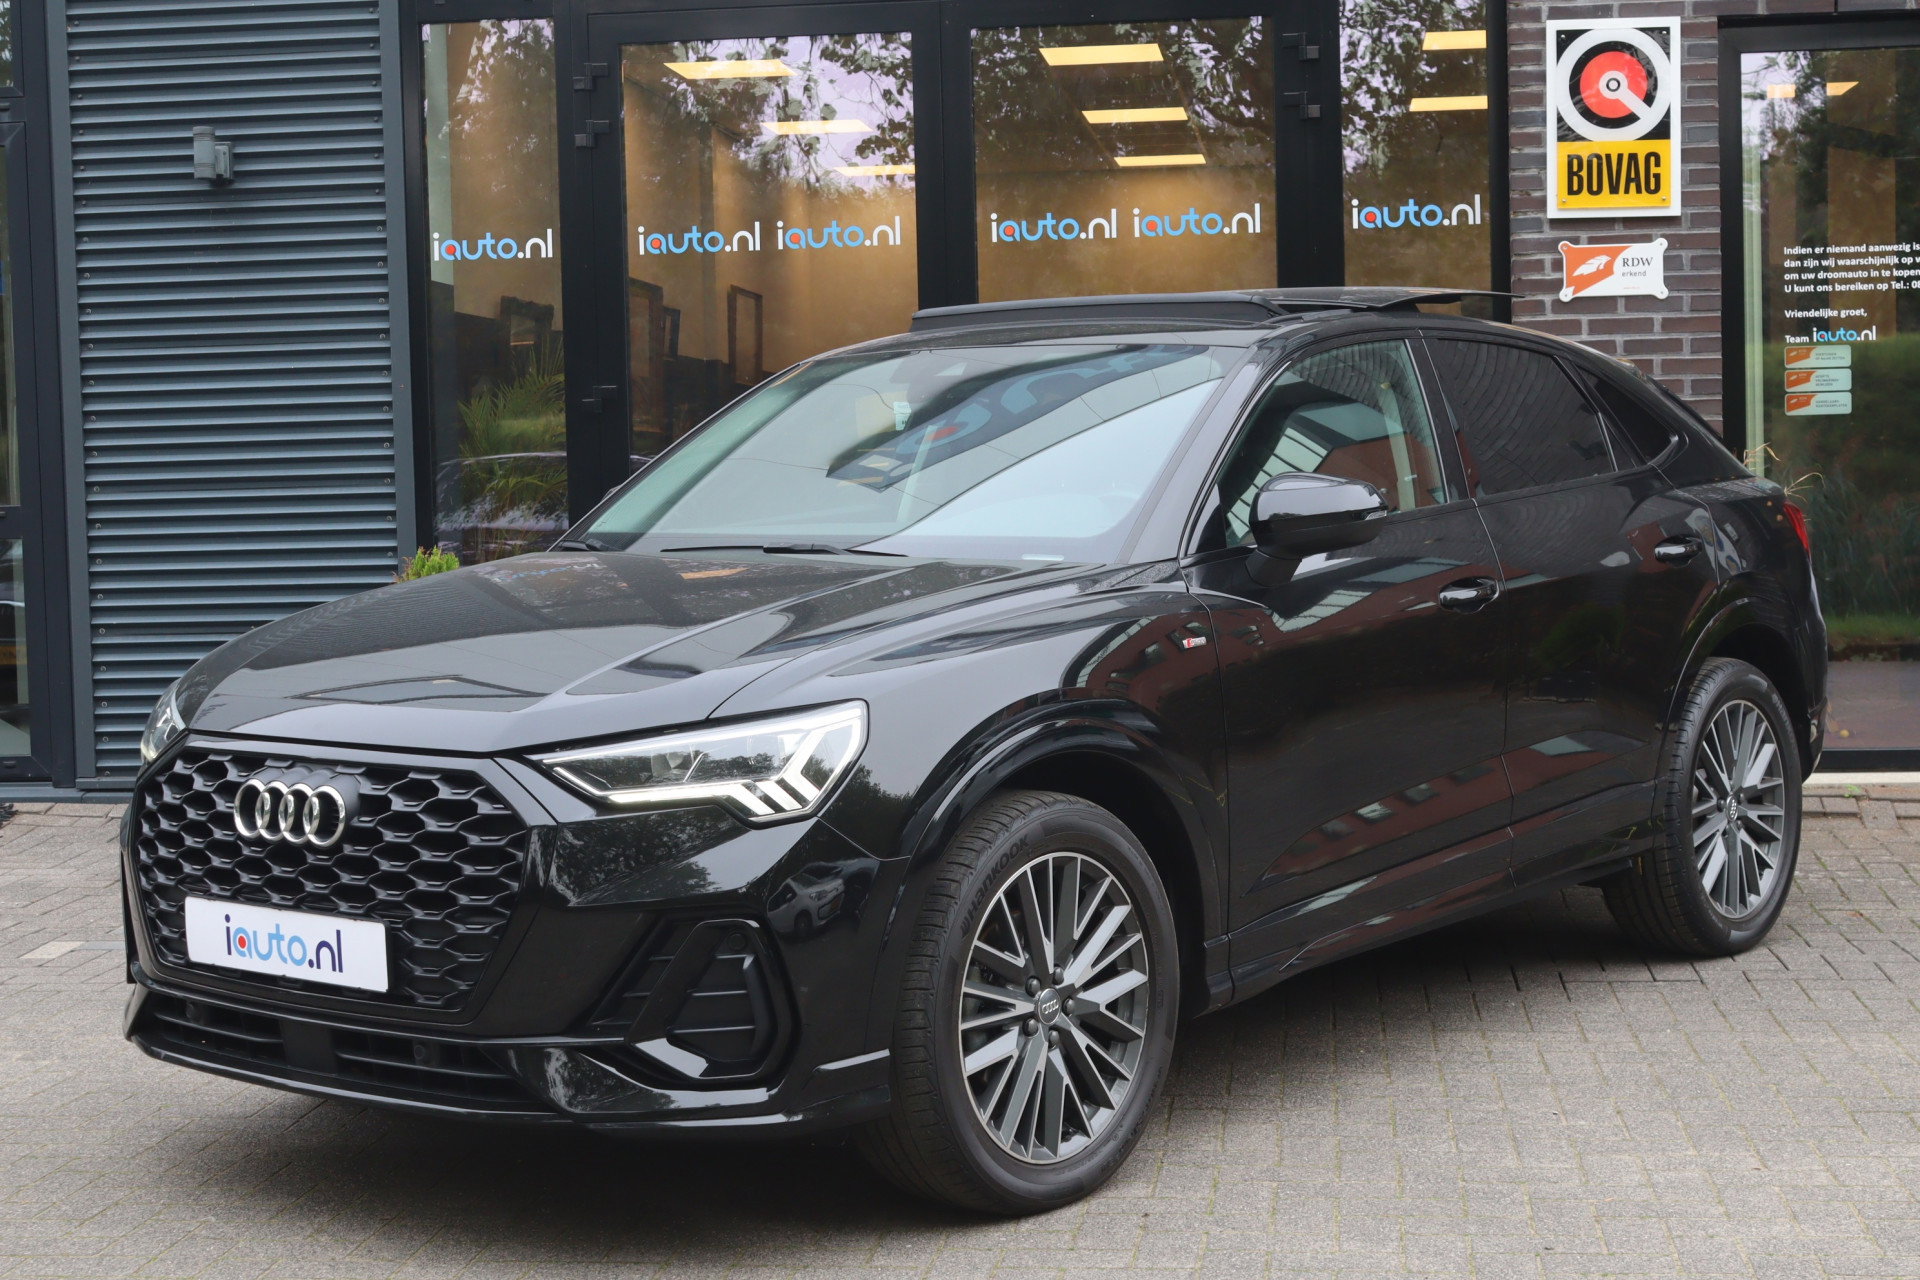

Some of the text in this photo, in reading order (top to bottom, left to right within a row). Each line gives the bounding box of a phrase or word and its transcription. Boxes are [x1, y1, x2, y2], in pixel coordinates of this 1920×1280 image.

[1567, 151, 1662, 196] BOVAG
[1352, 194, 1481, 229] iauto.nl
[991, 203, 1260, 242] iauto.nl iauto.nl
[433, 228, 553, 261] iauto.nl
[638, 216, 900, 255] iauto.nl iauto.nl
[1784, 246, 1812, 255] Indien
[1826, 244, 1866, 253] niemand
[1869, 242, 1911, 252] aanwezig
[1622, 257, 1653, 267] RDW
[1784, 259, 1801, 267] dan
[1803, 258, 1819, 268] zijn
[1821, 257, 1835, 267] wij
[1837, 255, 1899, 266] waarschijnlijk
[1901, 257, 1913, 265] op
[1817, 270, 1868, 279] droomauto
[1870, 269, 1879, 277] in
[1881, 269, 1891, 277] te
[1784, 284, 1792, 293] U
[1794, 284, 1814, 292] kunt
[1816, 284, 1833, 292] ons
[1835, 282, 1874, 291] bereiken
[1876, 283, 1888, 291] op
[1890, 280, 1910, 289] Tel.:
[1784, 308, 1867, 318] Vriendelijke groet,
[1785, 325, 1876, 343] Team iauto.nl
[224, 914, 344, 973] iauto.nl
